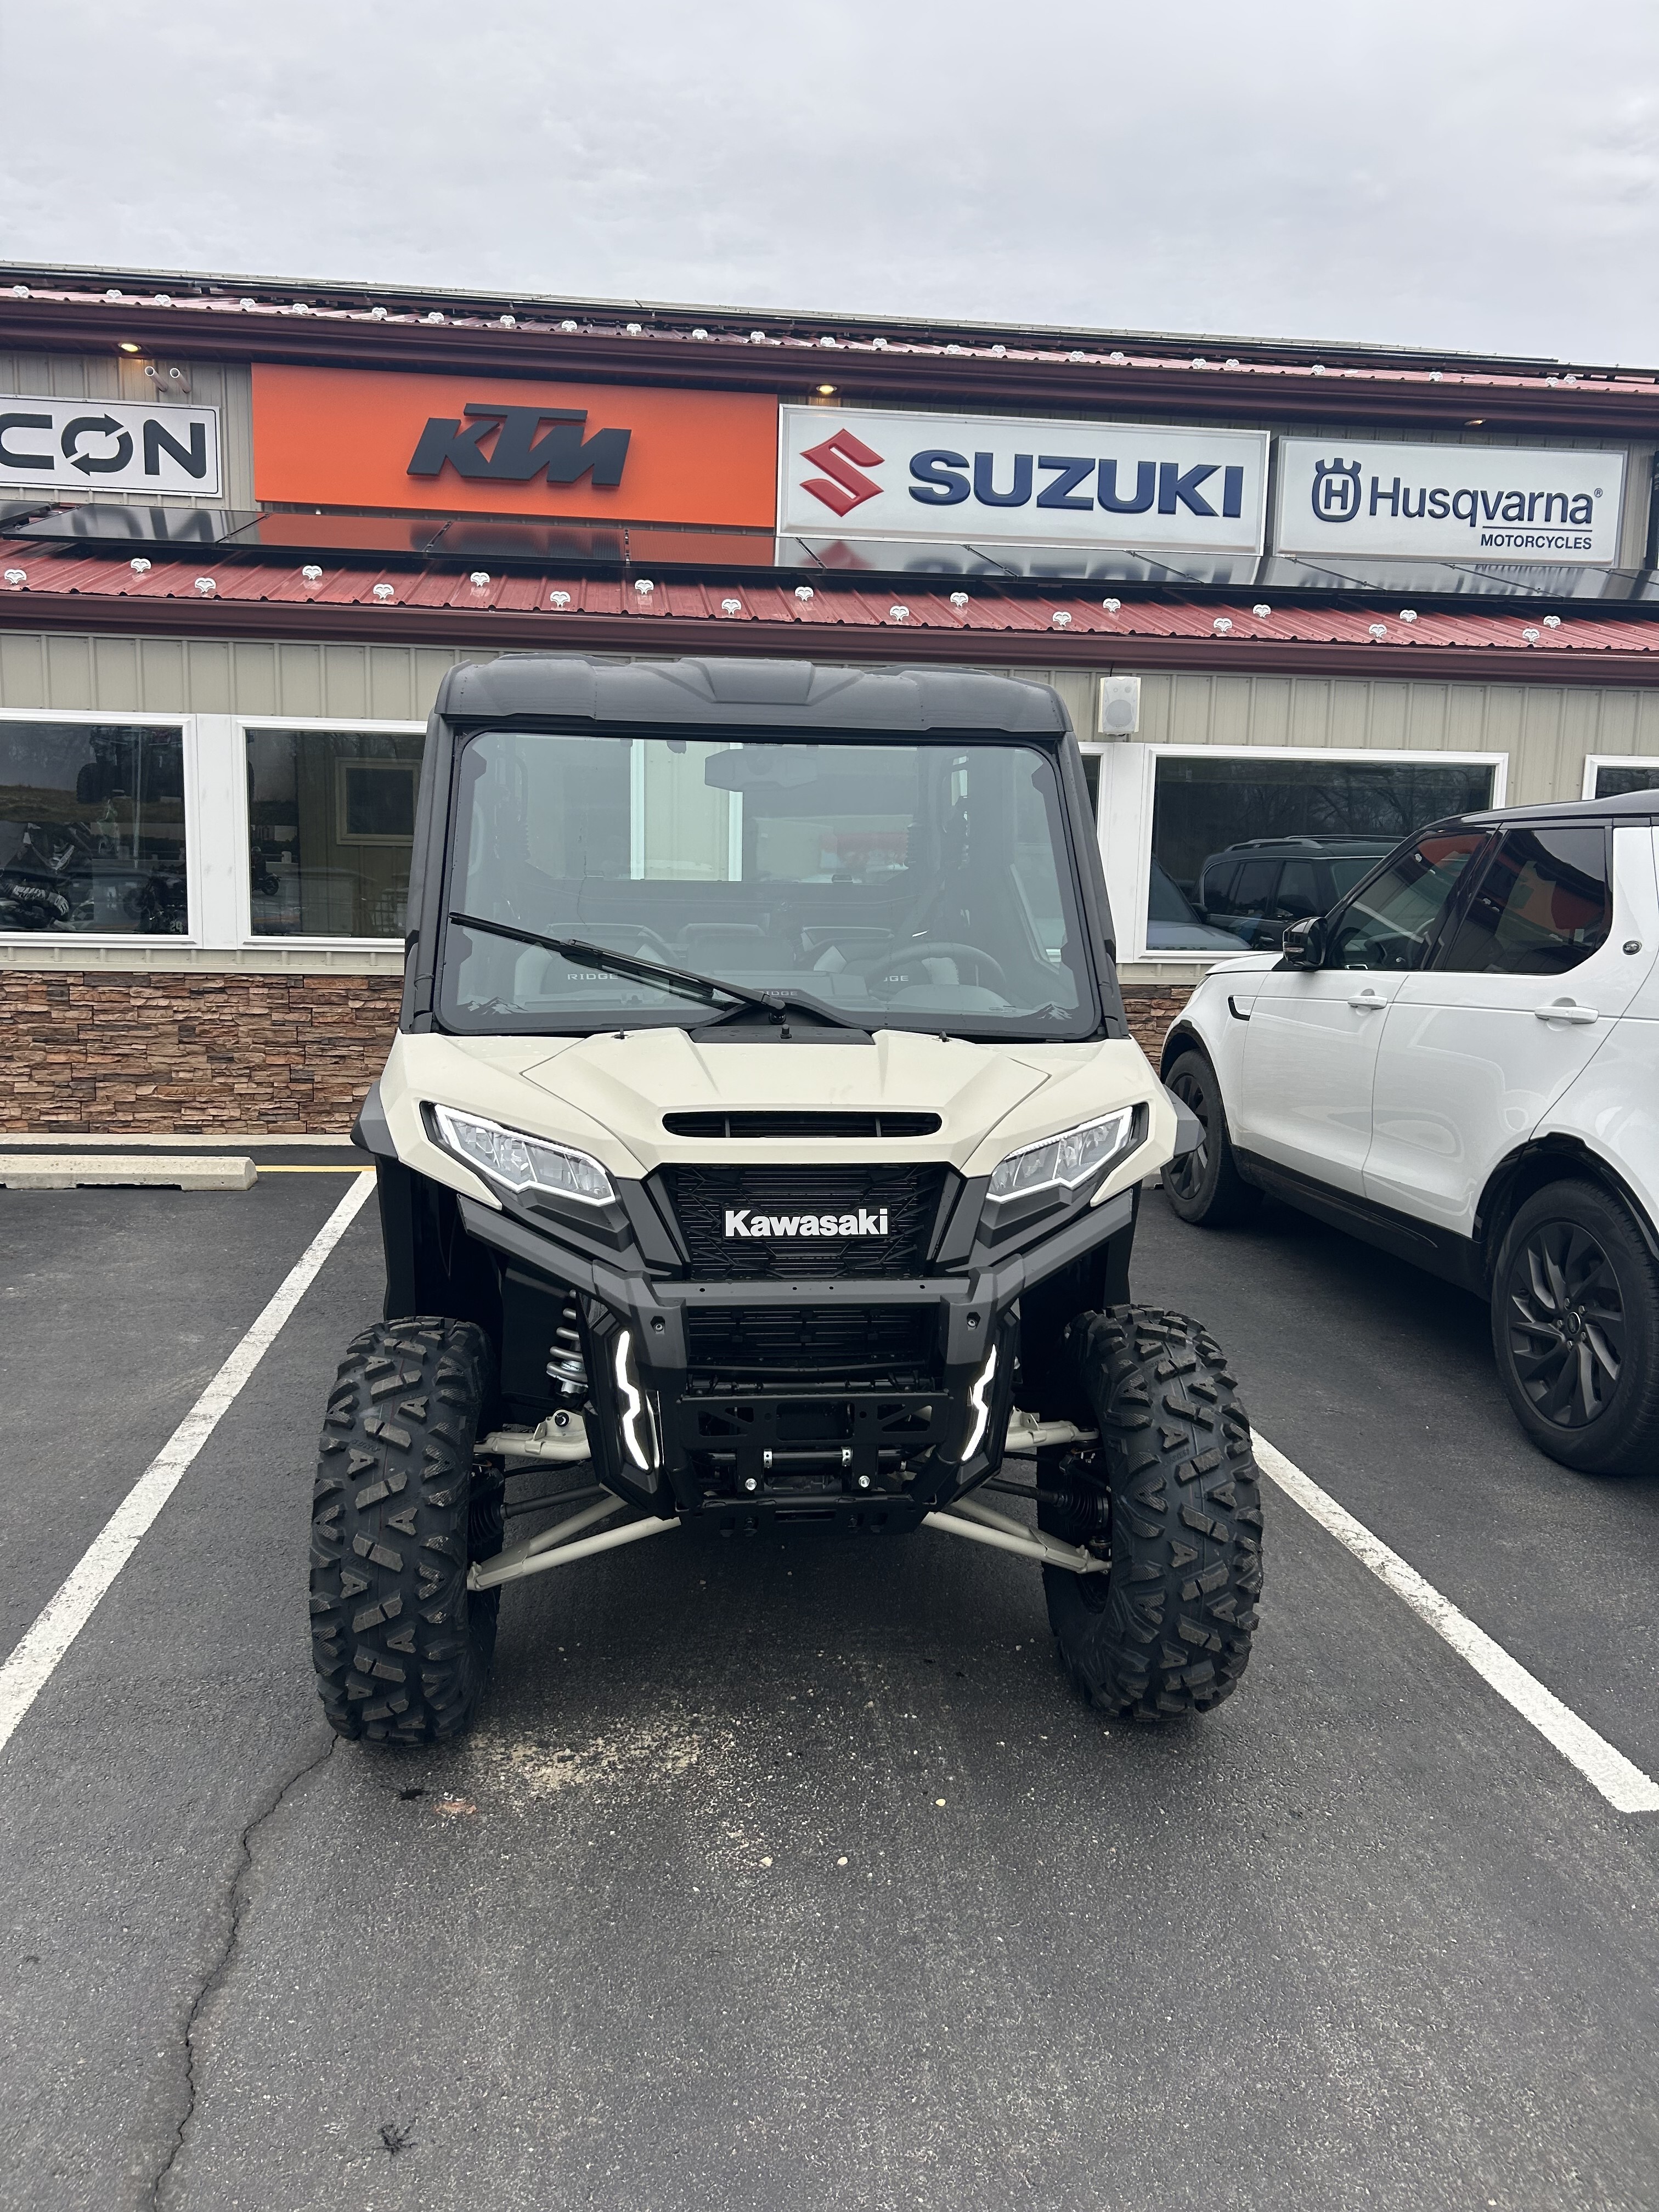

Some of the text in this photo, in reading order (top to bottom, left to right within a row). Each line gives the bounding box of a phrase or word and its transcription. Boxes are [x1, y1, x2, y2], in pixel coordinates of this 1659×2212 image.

[407, 403, 631, 487] KTM
[909, 449, 1244, 519] SUZUKI
[1480, 534, 1592, 549] MOTORCYCLES
[725, 1208, 888, 1237] Kawasaki
